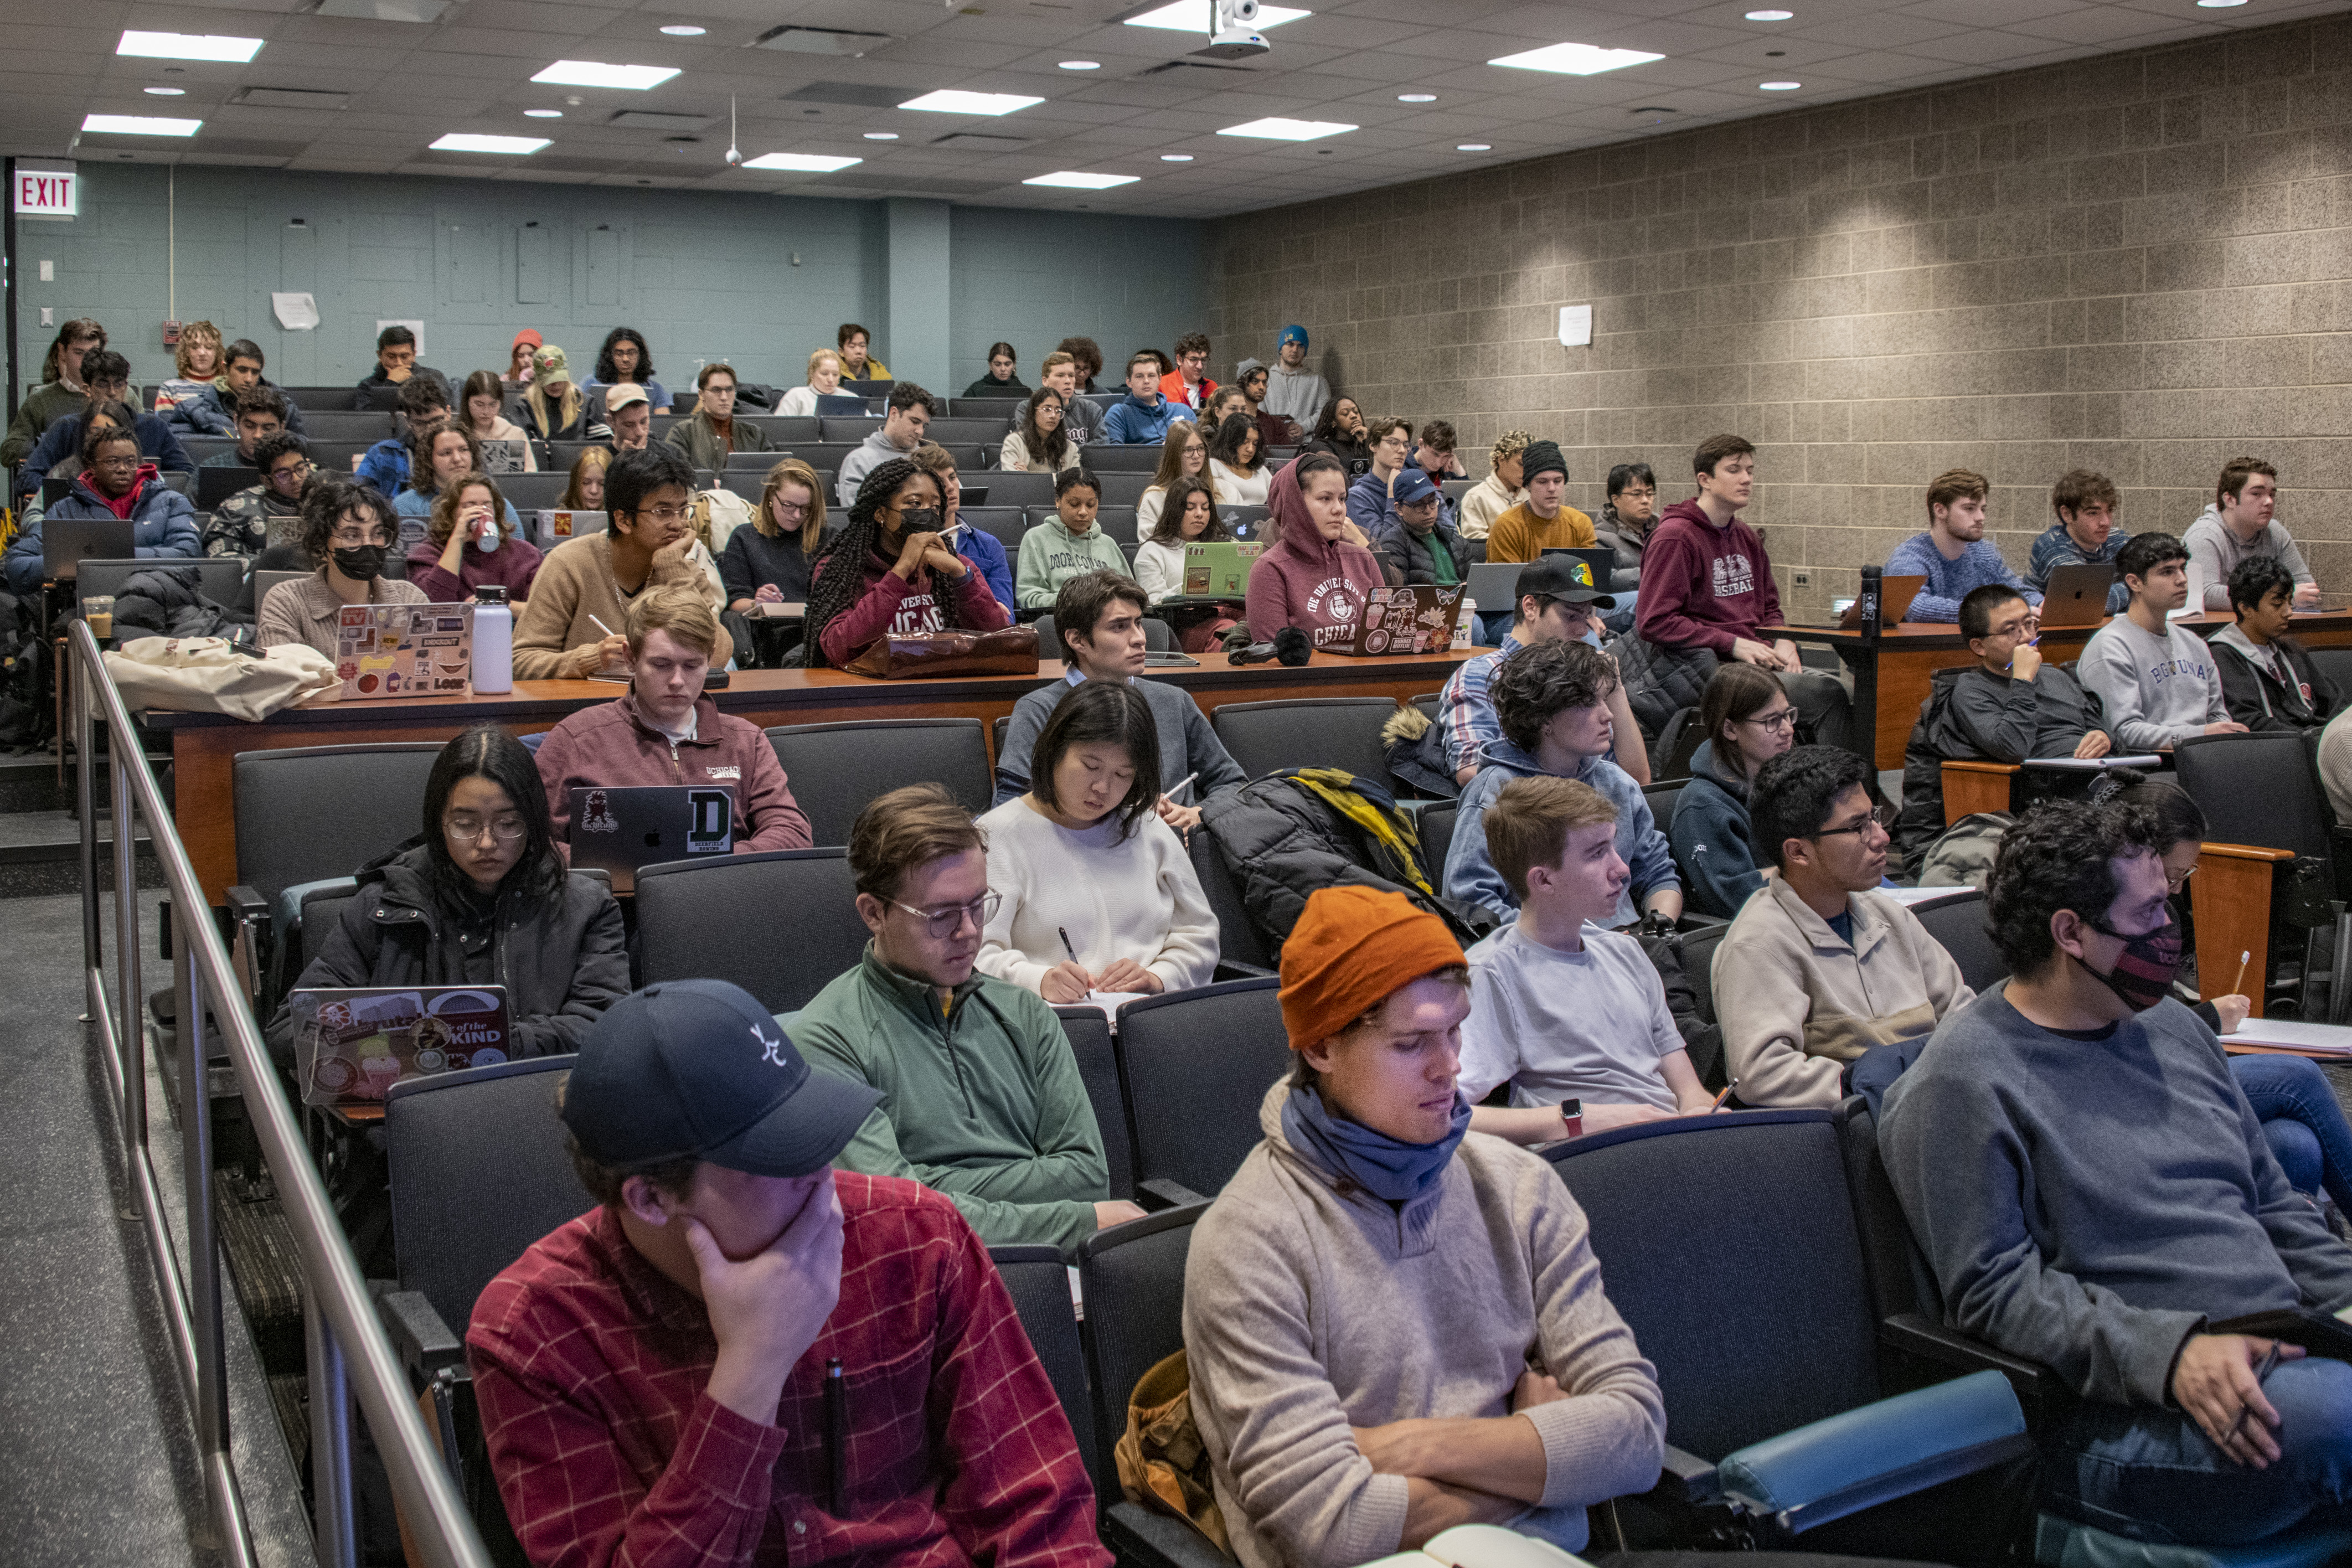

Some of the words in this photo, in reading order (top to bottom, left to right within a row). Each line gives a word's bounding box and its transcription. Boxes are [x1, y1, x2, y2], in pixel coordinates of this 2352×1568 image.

[22, 177, 70, 208] EXIT
[1307, 597, 1320, 613] THE
[343, 614, 364, 624] TV
[689, 791, 730, 842] D
[456, 1022, 470, 1033] of
[469, 1022, 487, 1030] the
[451, 1030, 501, 1045] KIND
